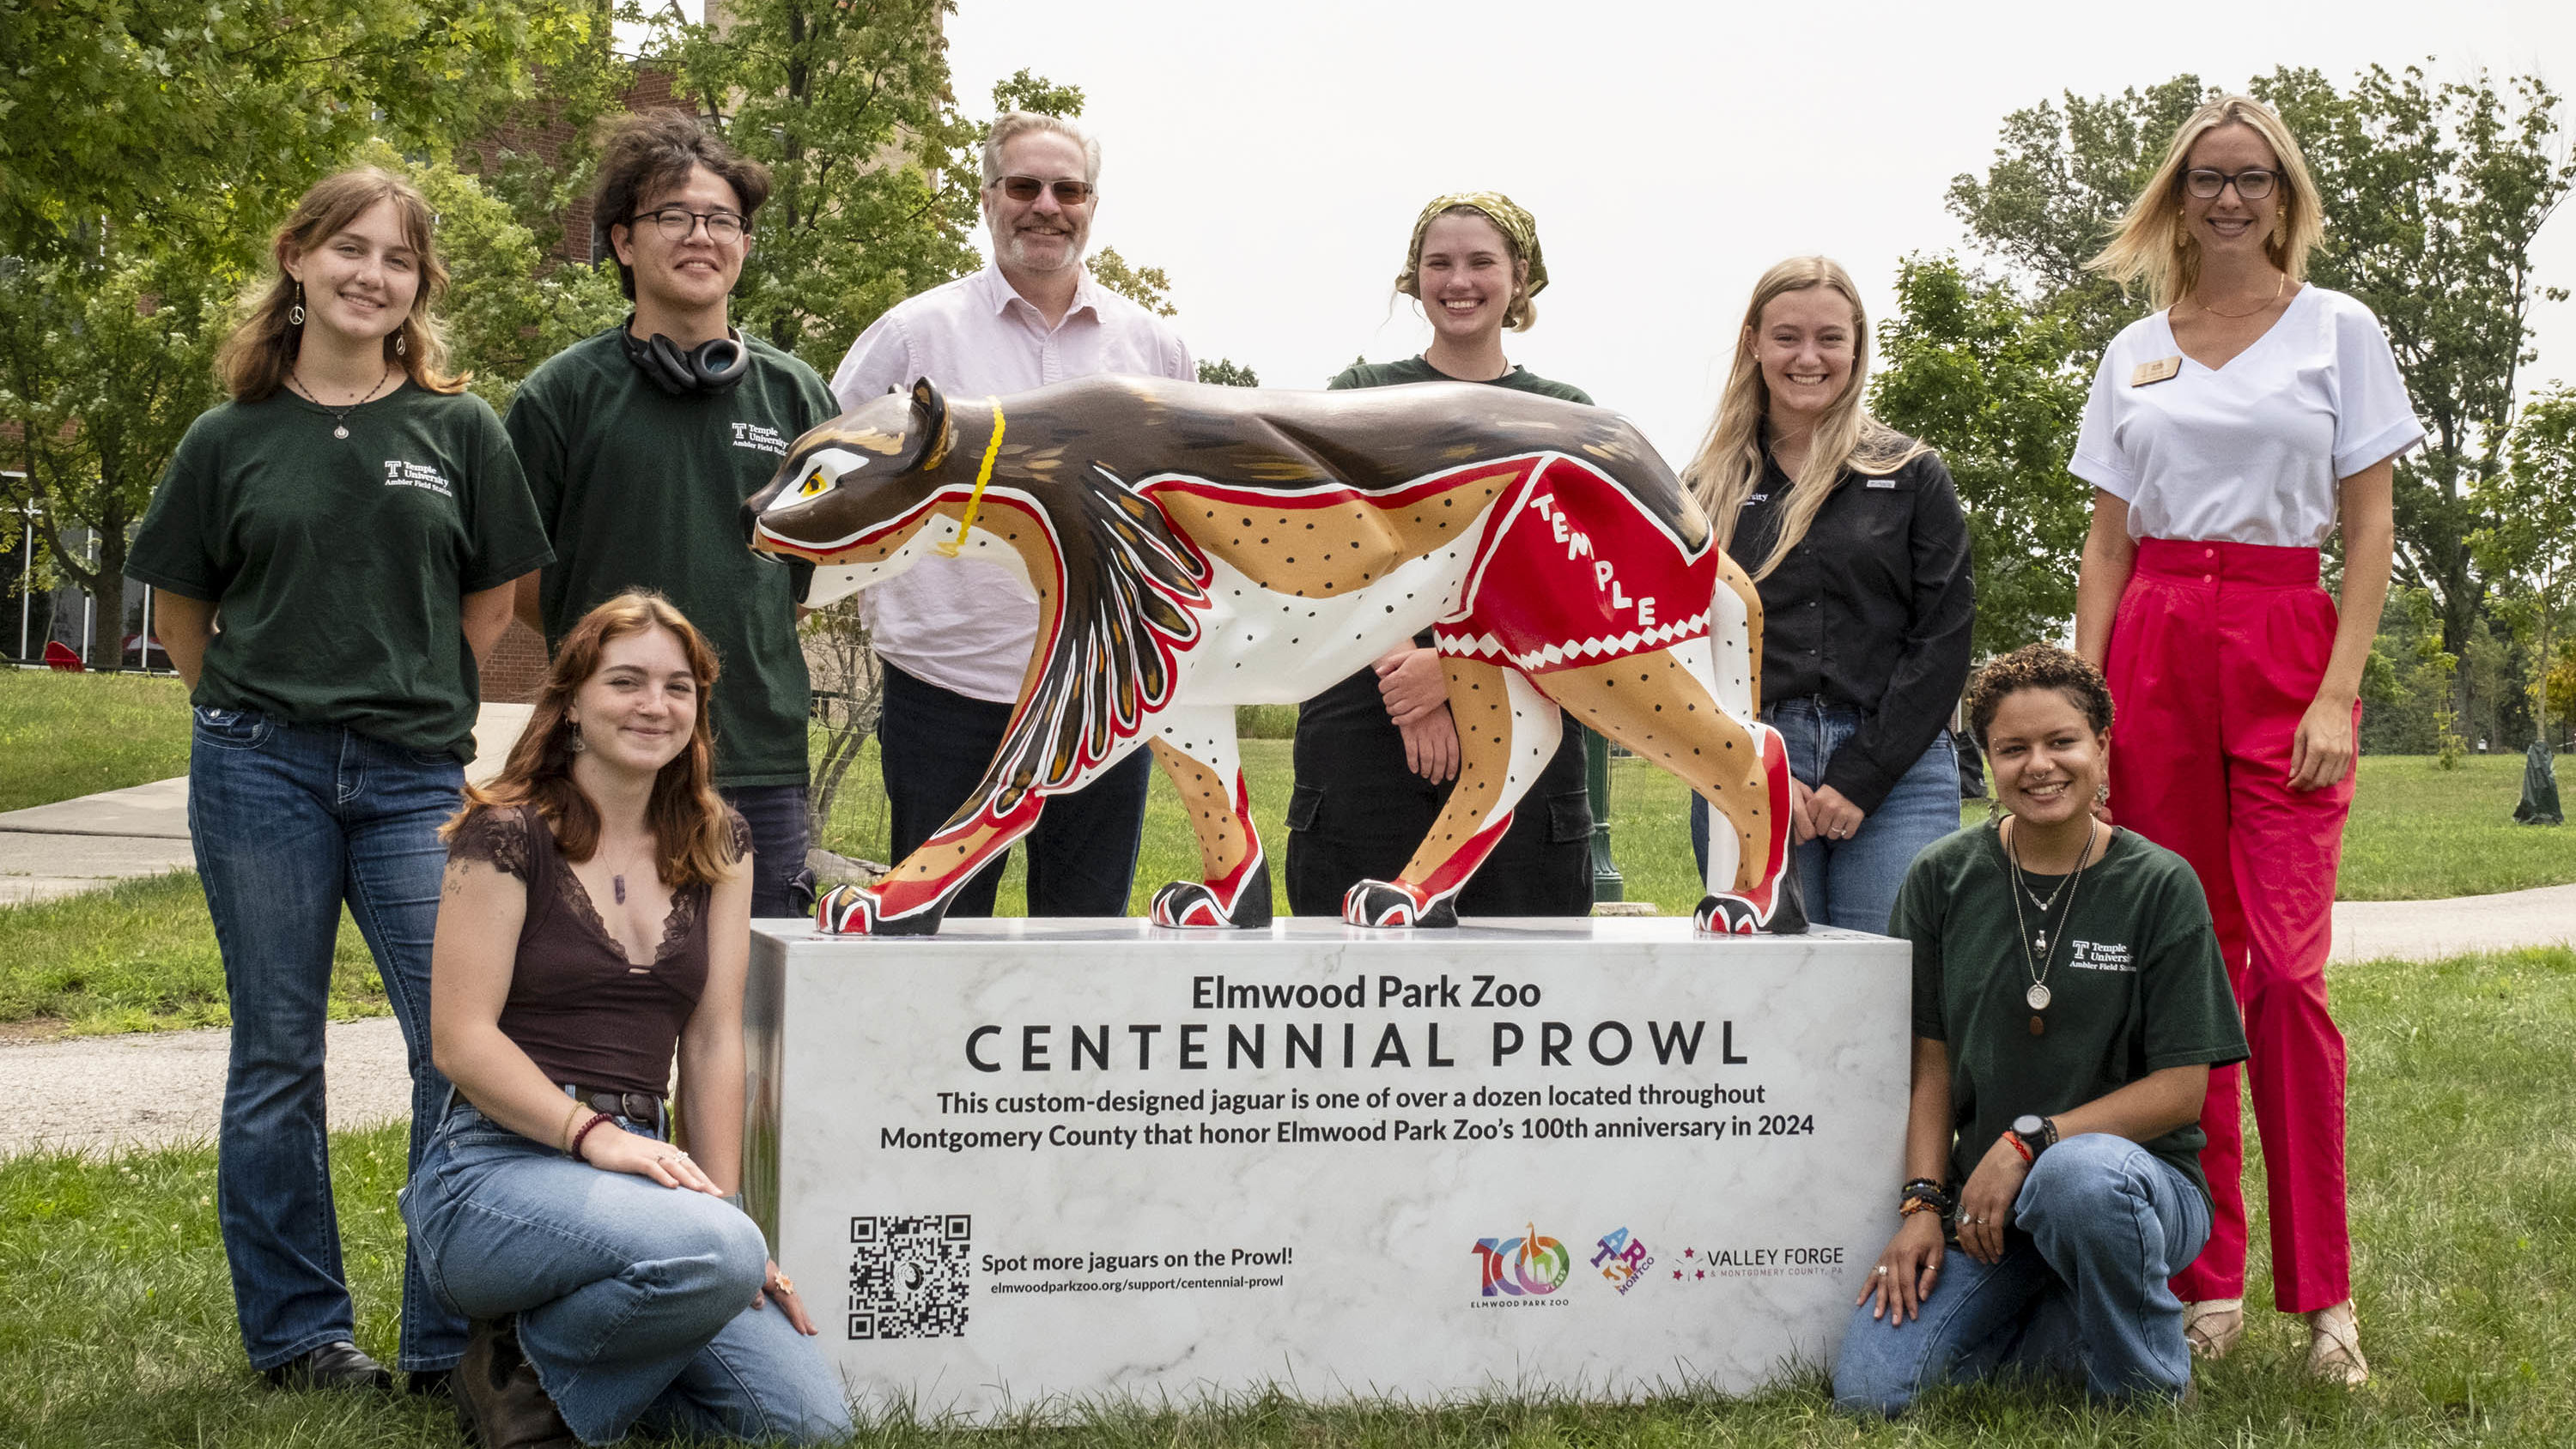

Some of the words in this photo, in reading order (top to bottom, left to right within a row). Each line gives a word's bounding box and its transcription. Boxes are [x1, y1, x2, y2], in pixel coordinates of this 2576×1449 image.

[748, 424, 778, 437] Temple
[732, 440, 756, 449] Ambler
[757, 444, 773, 452] Field
[749, 432, 789, 450] University
[404, 461, 437, 474] Temple
[404, 469, 449, 488] University
[414, 480, 431, 489] Field
[432, 484, 453, 497] Station
[1530, 494, 1656, 626] TEMPLE
[2092, 943, 2127, 954] Temple
[2069, 961, 2098, 969] Ambler
[2099, 962, 2118, 971] Field
[1193, 974, 1365, 1009] Elmwood
[1378, 974, 1461, 1008] Park
[1471, 975, 1541, 1008] Zoo
[965, 1022, 1455, 1073] CENTENNIAL
[1492, 1020, 1747, 1067] PROWL
[937, 1091, 988, 1114] This
[995, 1088, 1205, 1116] custom-designed
[1209, 1088, 1285, 1115] jaguar
[1291, 1088, 1309, 1109] is
[1315, 1093, 1360, 1109] one
[1366, 1087, 1391, 1108] of
[1395, 1092, 1449, 1108] over
[1453, 1091, 1466, 1107] a
[1473, 1085, 1541, 1107] dozen
[1548, 1083, 1631, 1106] located
[1637, 1082, 1765, 1109] throughout
[881, 1127, 1043, 1154] Montgomery
[1048, 1125, 1138, 1150] County
[1143, 1123, 1193, 1145] that
[1200, 1122, 1272, 1144] honor
[1277, 1119, 1387, 1143] Elmwood
[1394, 1119, 1447, 1141] Park
[1453, 1118, 1514, 1140] Zoo’s
[1522, 1117, 1588, 1139] 100th
[1595, 1116, 1727, 1141] anniversary
[1732, 1115, 1752, 1137] in
[1758, 1114, 1814, 1136] 2024
[981, 1254, 1028, 1276] Spot
[1033, 1257, 1084, 1271] more
[1087, 1252, 1159, 1274] jaguars
[1163, 1254, 1188, 1268] on
[1194, 1249, 1225, 1267] the
[1231, 1246, 1292, 1266] Prowl!
[1707, 1249, 1778, 1267] VALLEY
[1784, 1247, 1844, 1265] FORGE
[1619, 1257, 1655, 1295] MONTCO
[1721, 1268, 1784, 1277] MONTGOMERY
[1789, 1267, 1828, 1276] COUNTY,
[1832, 1266, 1843, 1275] PA
[990, 1275, 1284, 1294] elmwoodparkzoo.org/support/centennial-prowl
[1471, 1300, 1520, 1309] ELMWOOD
